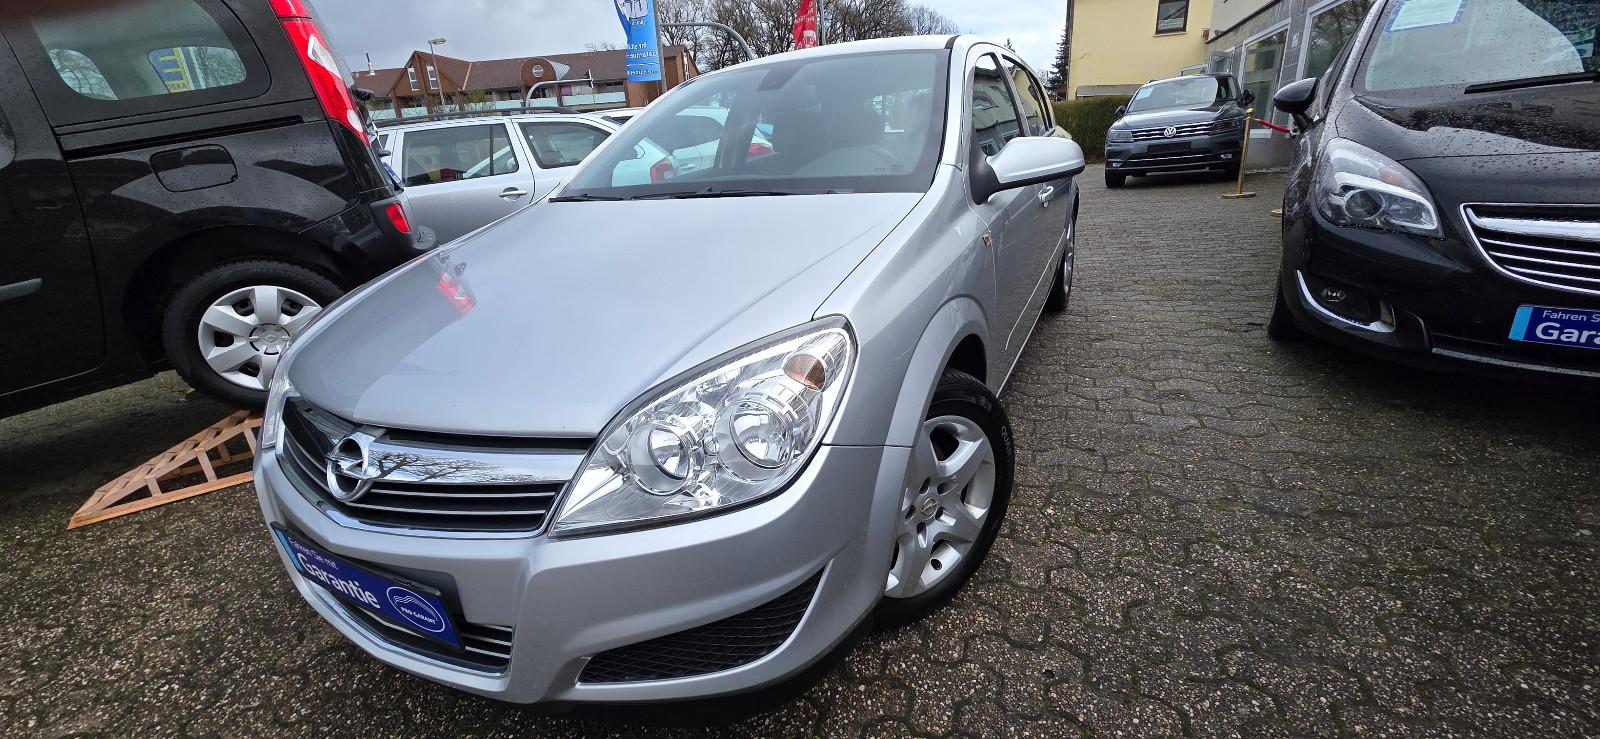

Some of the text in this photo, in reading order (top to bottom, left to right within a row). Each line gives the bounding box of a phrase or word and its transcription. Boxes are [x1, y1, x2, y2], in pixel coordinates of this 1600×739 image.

[1542, 310, 1587, 322] Fahren
[297, 552, 381, 609] Garantie
[400, 606, 436, 625] PRO GARANT
